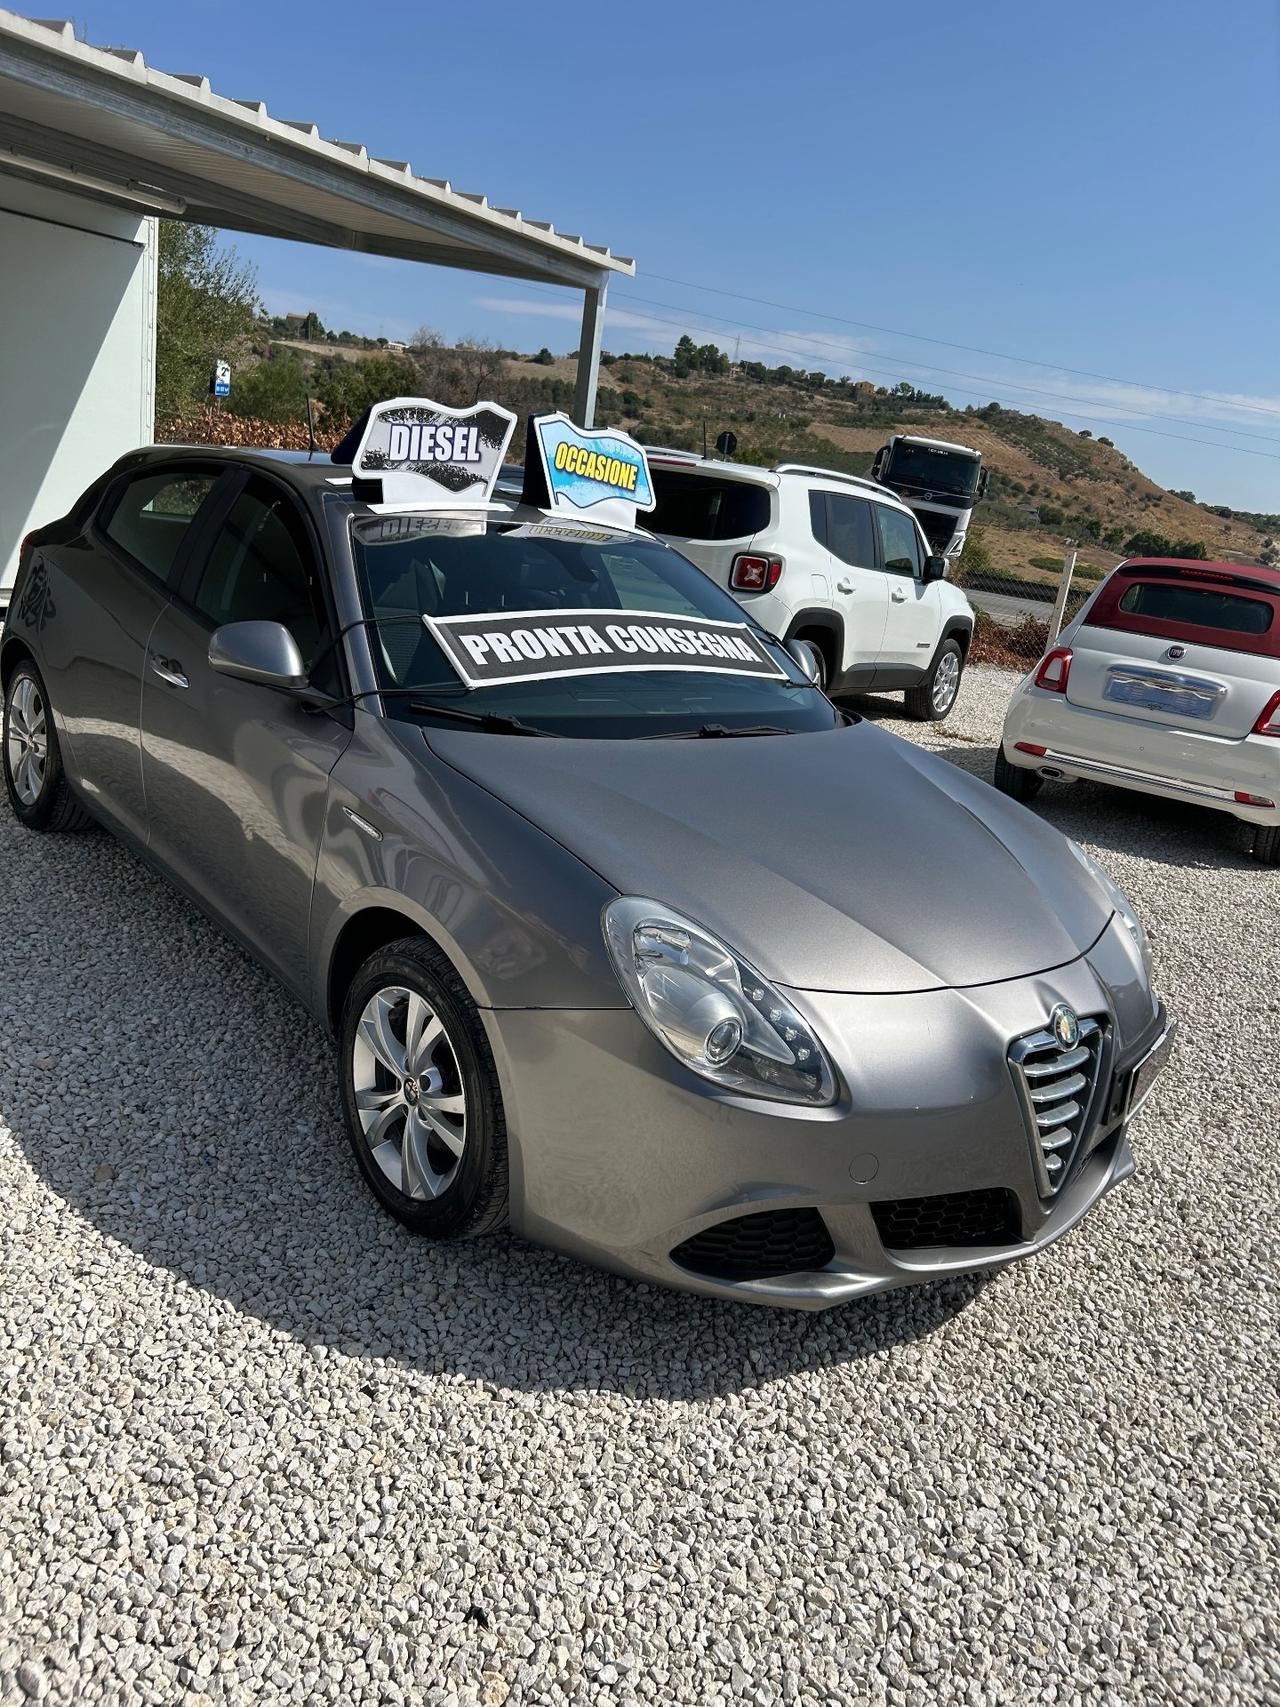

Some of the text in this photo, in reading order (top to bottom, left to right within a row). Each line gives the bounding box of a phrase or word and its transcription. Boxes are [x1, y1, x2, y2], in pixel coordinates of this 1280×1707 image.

[389, 425, 481, 462] DIESEL
[554, 441, 639, 491] OCCASIONE
[458, 624, 763, 665] PRONTA CONSEGNA
